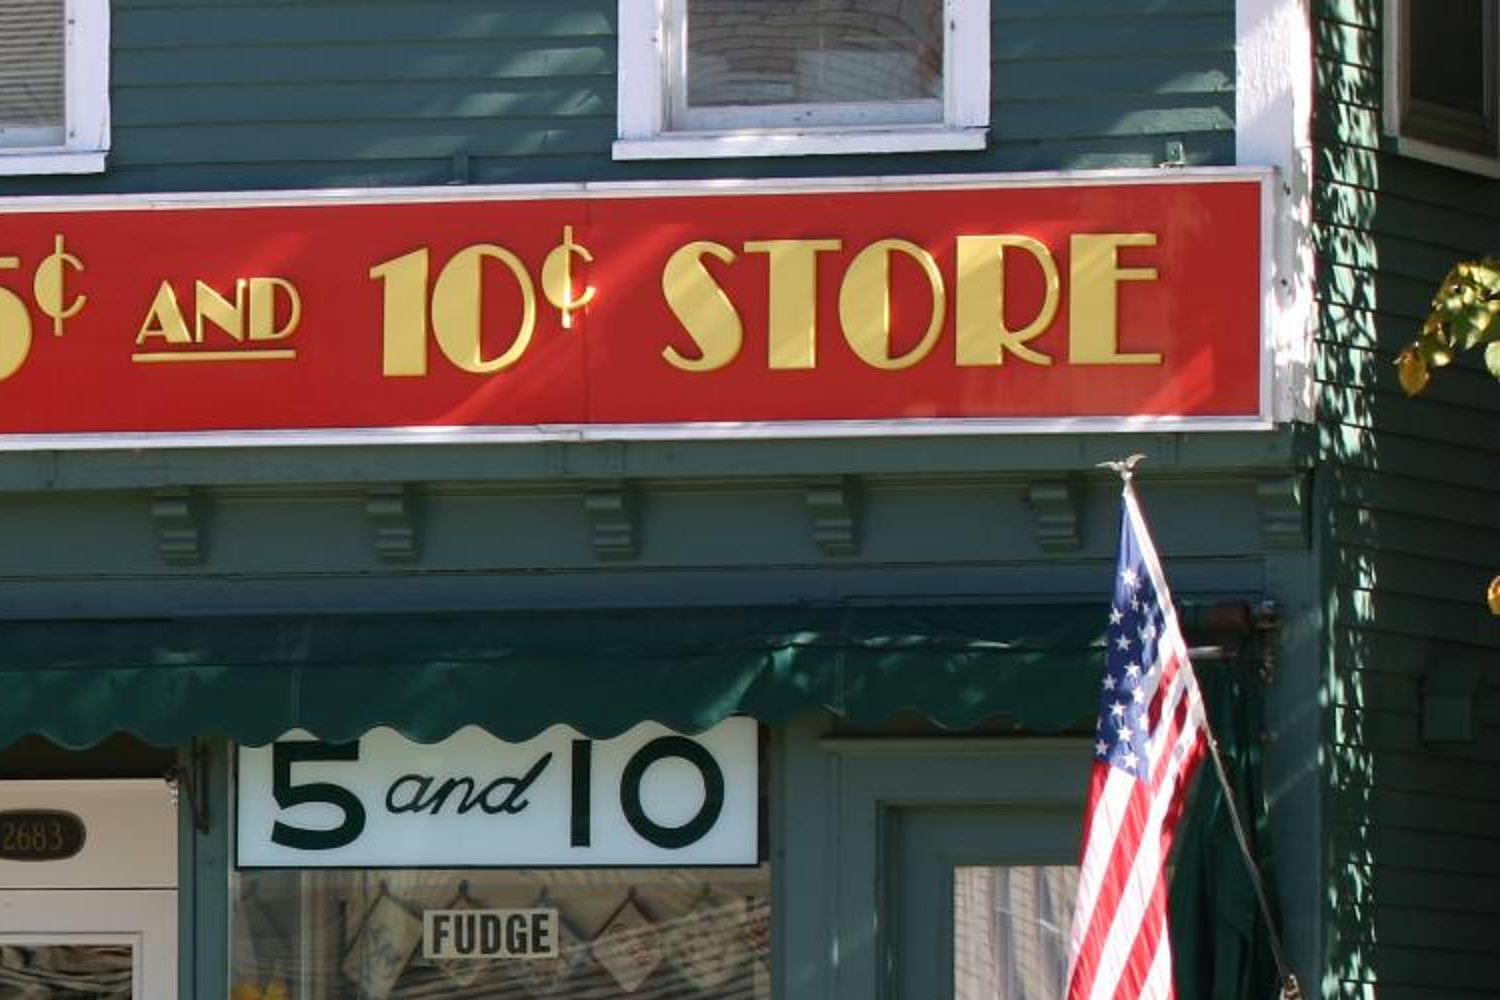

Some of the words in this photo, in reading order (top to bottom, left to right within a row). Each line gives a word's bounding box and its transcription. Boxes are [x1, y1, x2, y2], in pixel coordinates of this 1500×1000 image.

[134, 277, 301, 344] AND
[661, 231, 1163, 373] STORE
[269, 738, 367, 851] 5
[385, 752, 553, 815] and
[569, 734, 725, 849] 10
[431, 912, 552, 956] FUDGE
